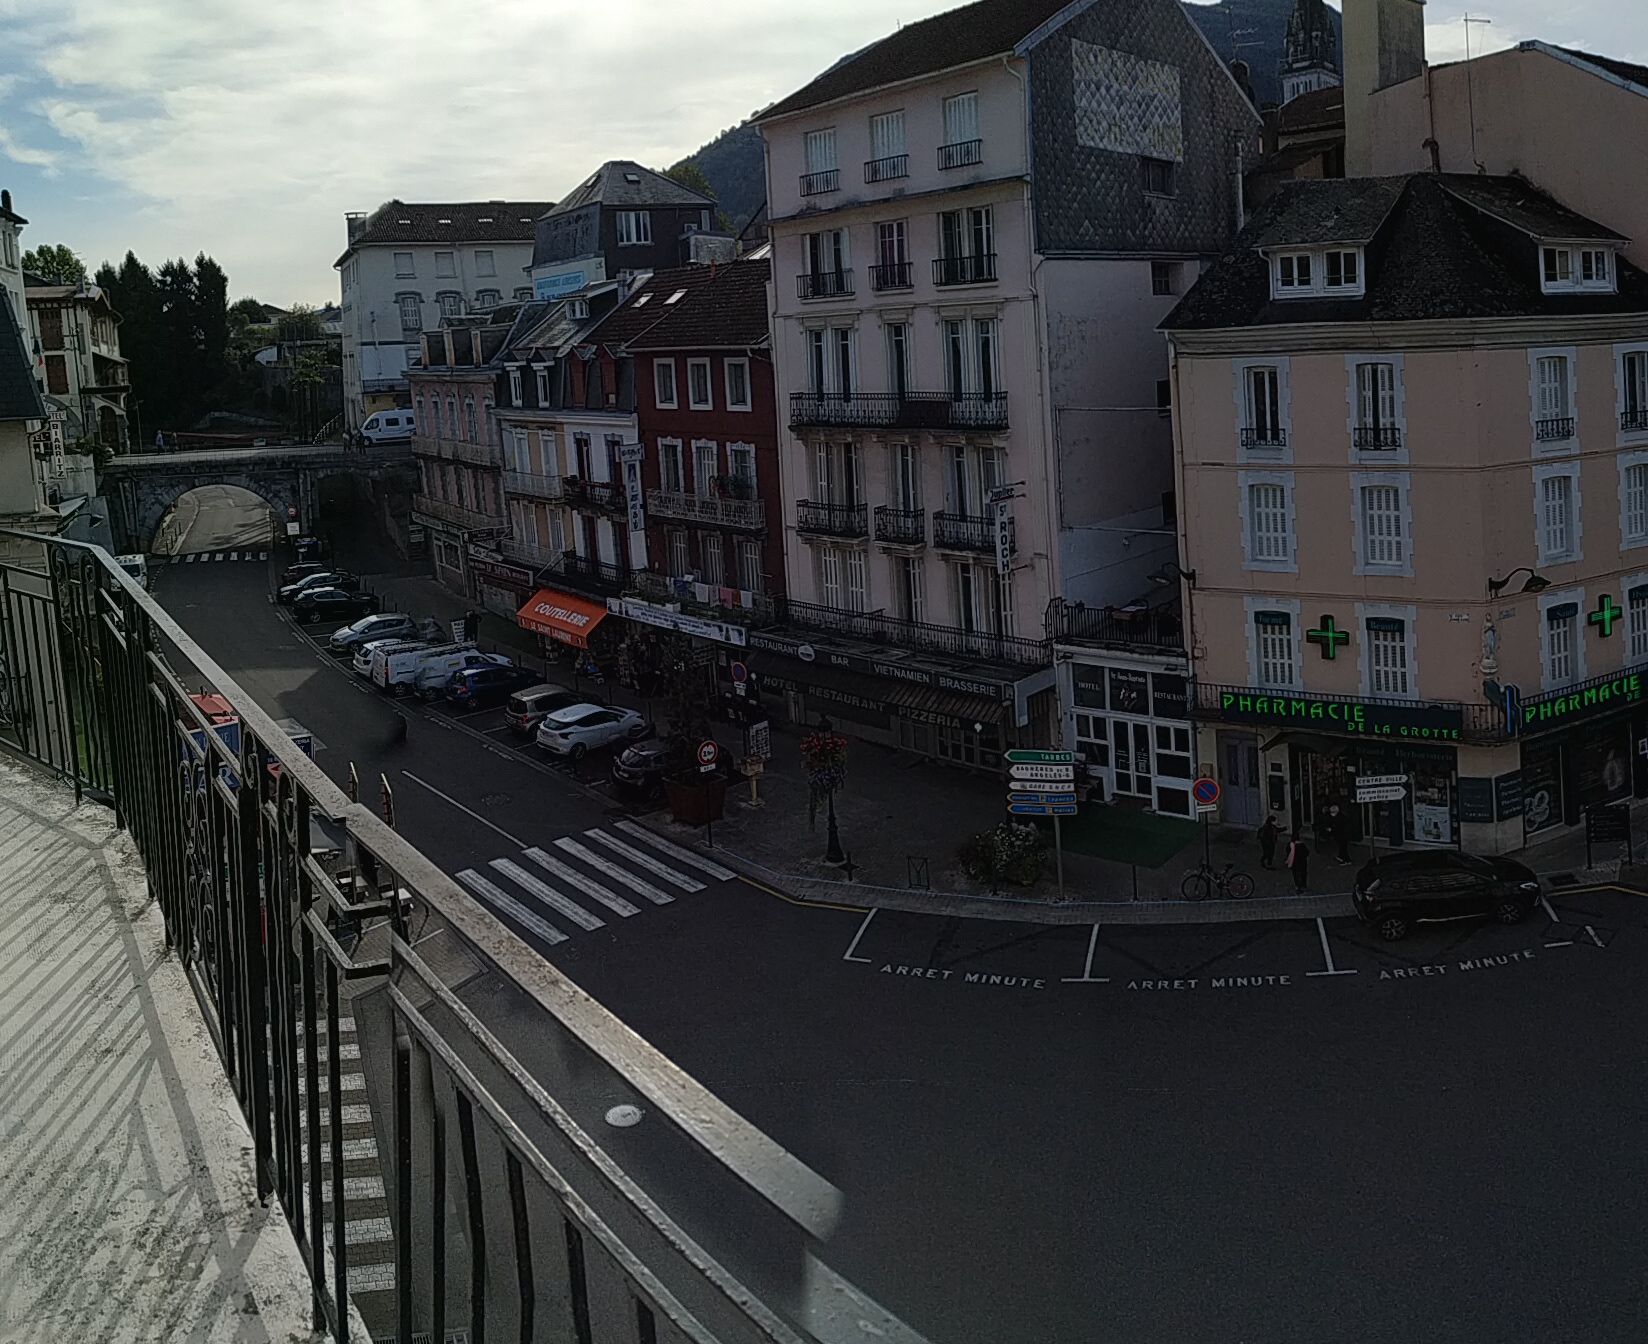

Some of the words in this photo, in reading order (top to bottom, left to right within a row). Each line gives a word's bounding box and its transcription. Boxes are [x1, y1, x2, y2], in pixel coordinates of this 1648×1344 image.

[52, 423, 64, 477] BIARRITZ
[1000, 521, 1010, 572] ROCH
[534, 602, 590, 628] COUTELLERIE
[750, 637, 798, 656] RESTAURANT
[830, 653, 850, 667] BAR
[873, 663, 930, 684] VIETNAMIEN
[938, 676, 997, 697] BRASSERIE
[1078, 682, 1100, 691] HOTEL
[1524, 674, 1641, 724] PHARMACIE
[1626, 692, 1641, 702] DE
[763, 675, 799, 693] HOTEL
[808, 686, 886, 713] RESTAURANT
[898, 706, 961, 730] PIZZERIA
[1222, 694, 1366, 722] PHARMACIE
[1347, 722, 1365, 732] DE
[1374, 723, 1391, 734] LA
[1400, 726, 1461, 739] GROTTE
[1040, 753, 1071, 761] TARBES
[1357, 777, 1382, 785] CENTRE
[879, 963, 954, 981] ARRET
[963, 972, 1047, 990] MINUTE
[1379, 963, 1449, 981] ARRET
[1458, 949, 1536, 972] MINUTE
[1126, 978, 1199, 991] ARRET
[1210, 974, 1292, 989] MINUTE
